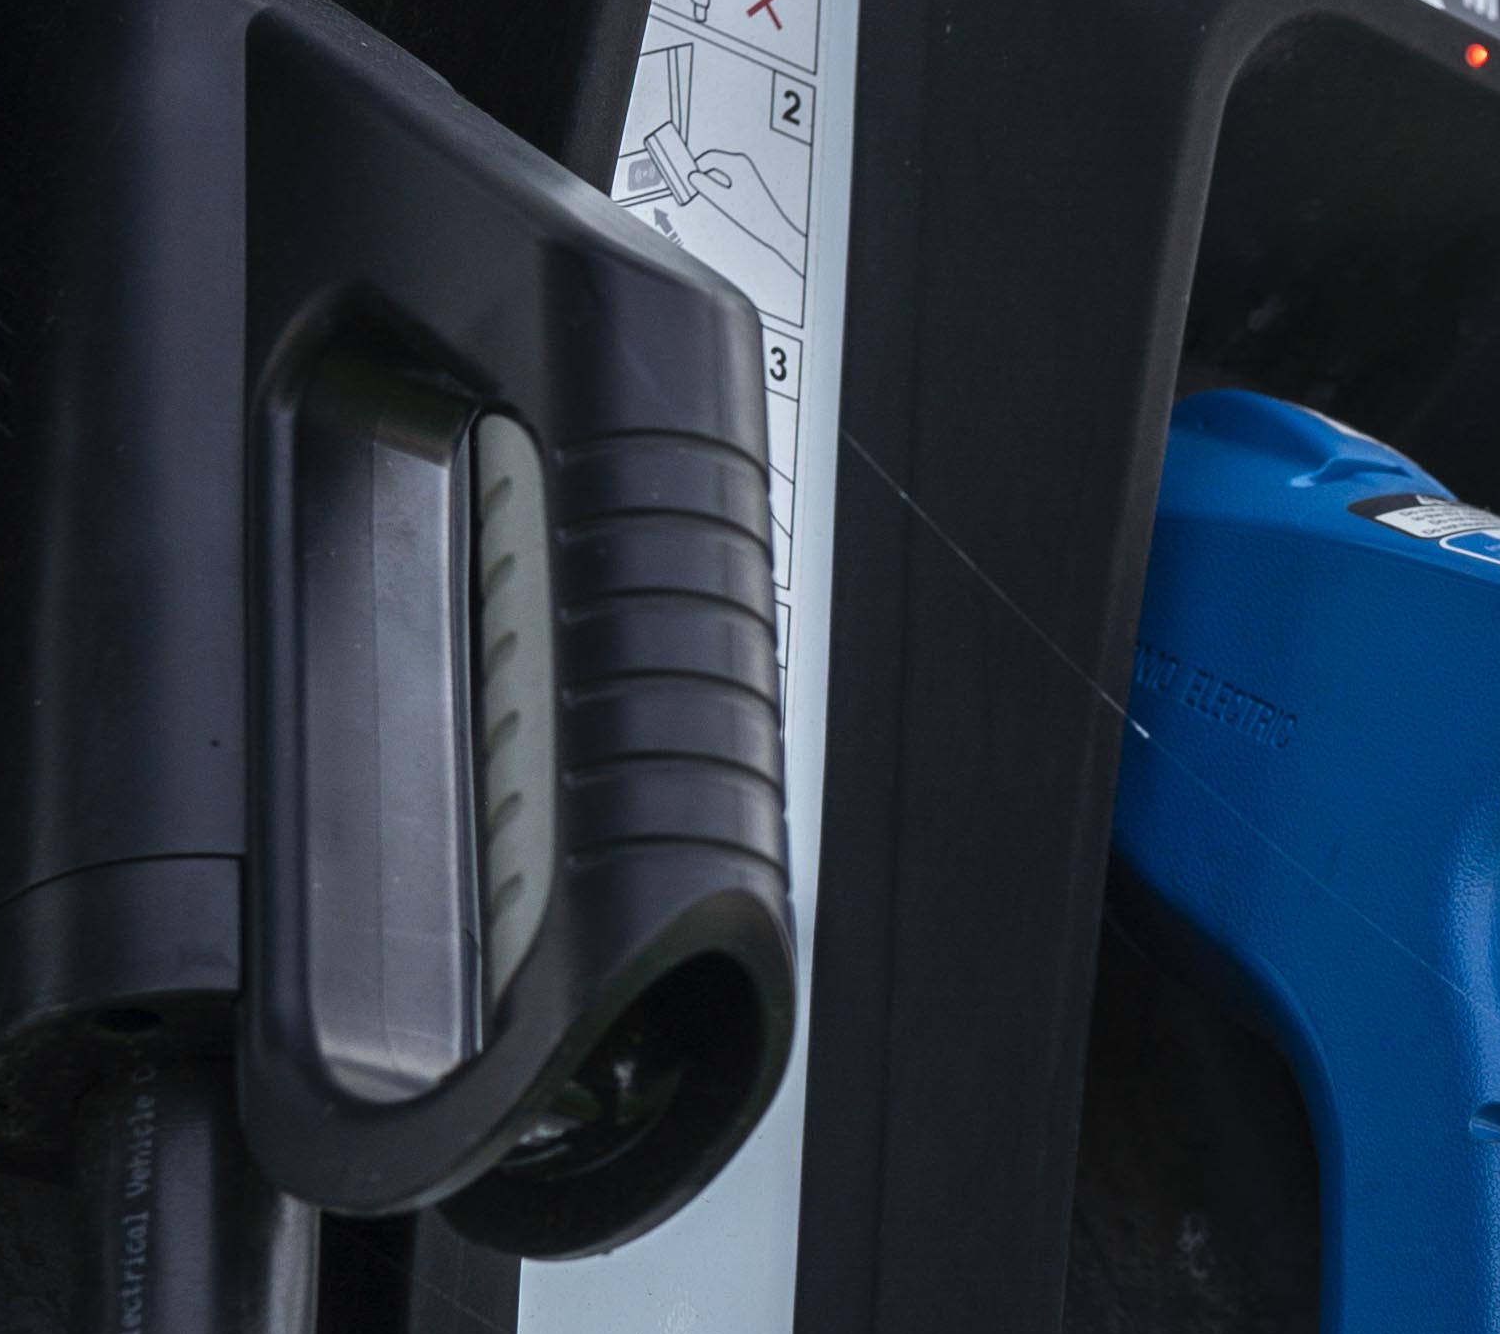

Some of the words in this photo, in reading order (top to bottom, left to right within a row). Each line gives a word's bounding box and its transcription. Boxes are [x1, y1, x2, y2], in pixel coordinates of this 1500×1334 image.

[781, 90, 801, 124] 2
[769, 346, 787, 382] 3
[1181, 669, 1297, 749] ELECTRIC
[124, 1093, 156, 1200] Vehicle
